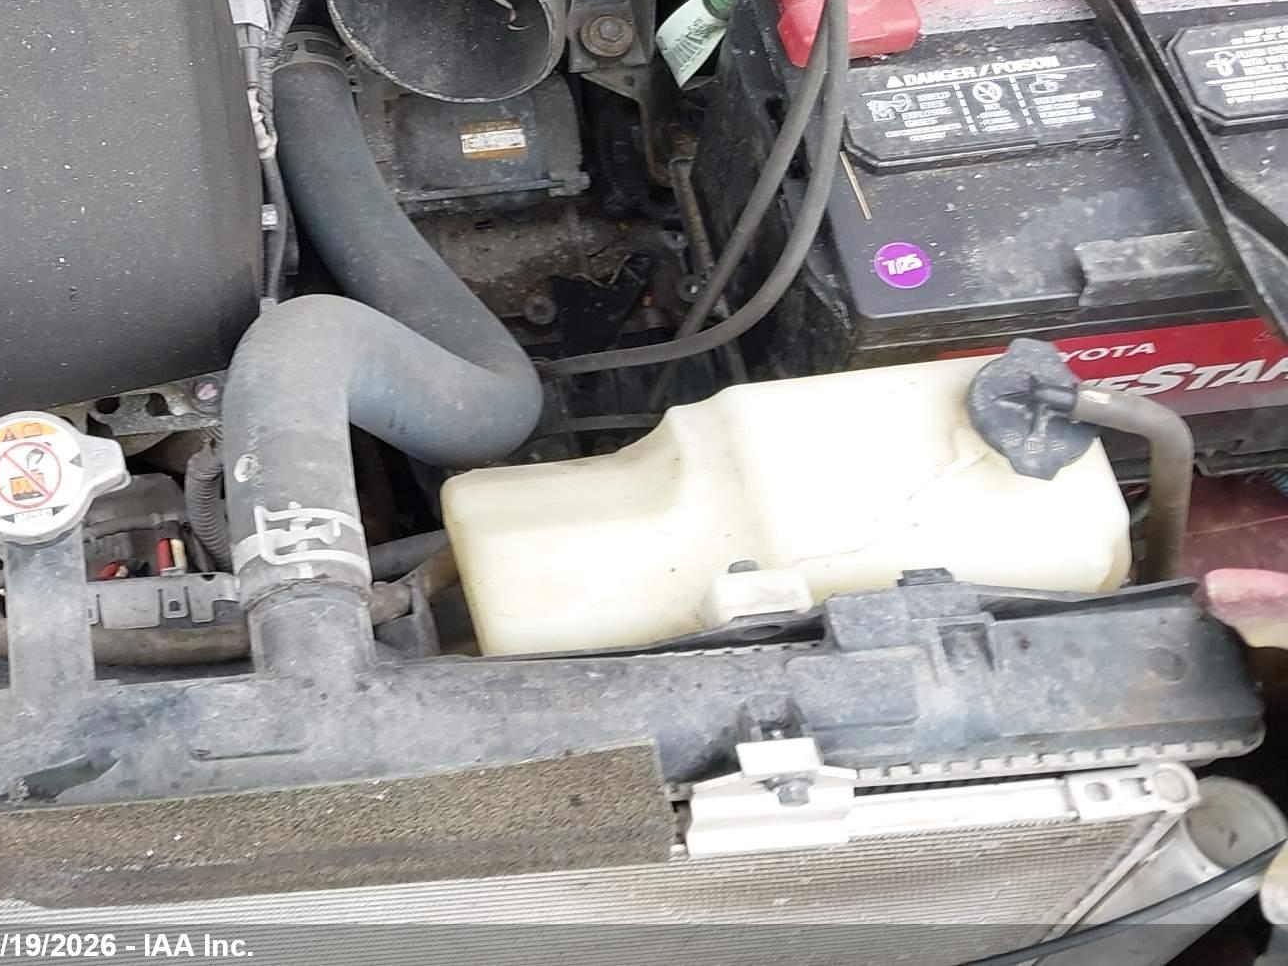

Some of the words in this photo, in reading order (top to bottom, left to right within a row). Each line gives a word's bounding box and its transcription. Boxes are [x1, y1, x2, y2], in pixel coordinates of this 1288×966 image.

[903, 65, 978, 88] DANGER
[993, 56, 1061, 76] POISON
[1058, 342, 1156, 364] YOTA
